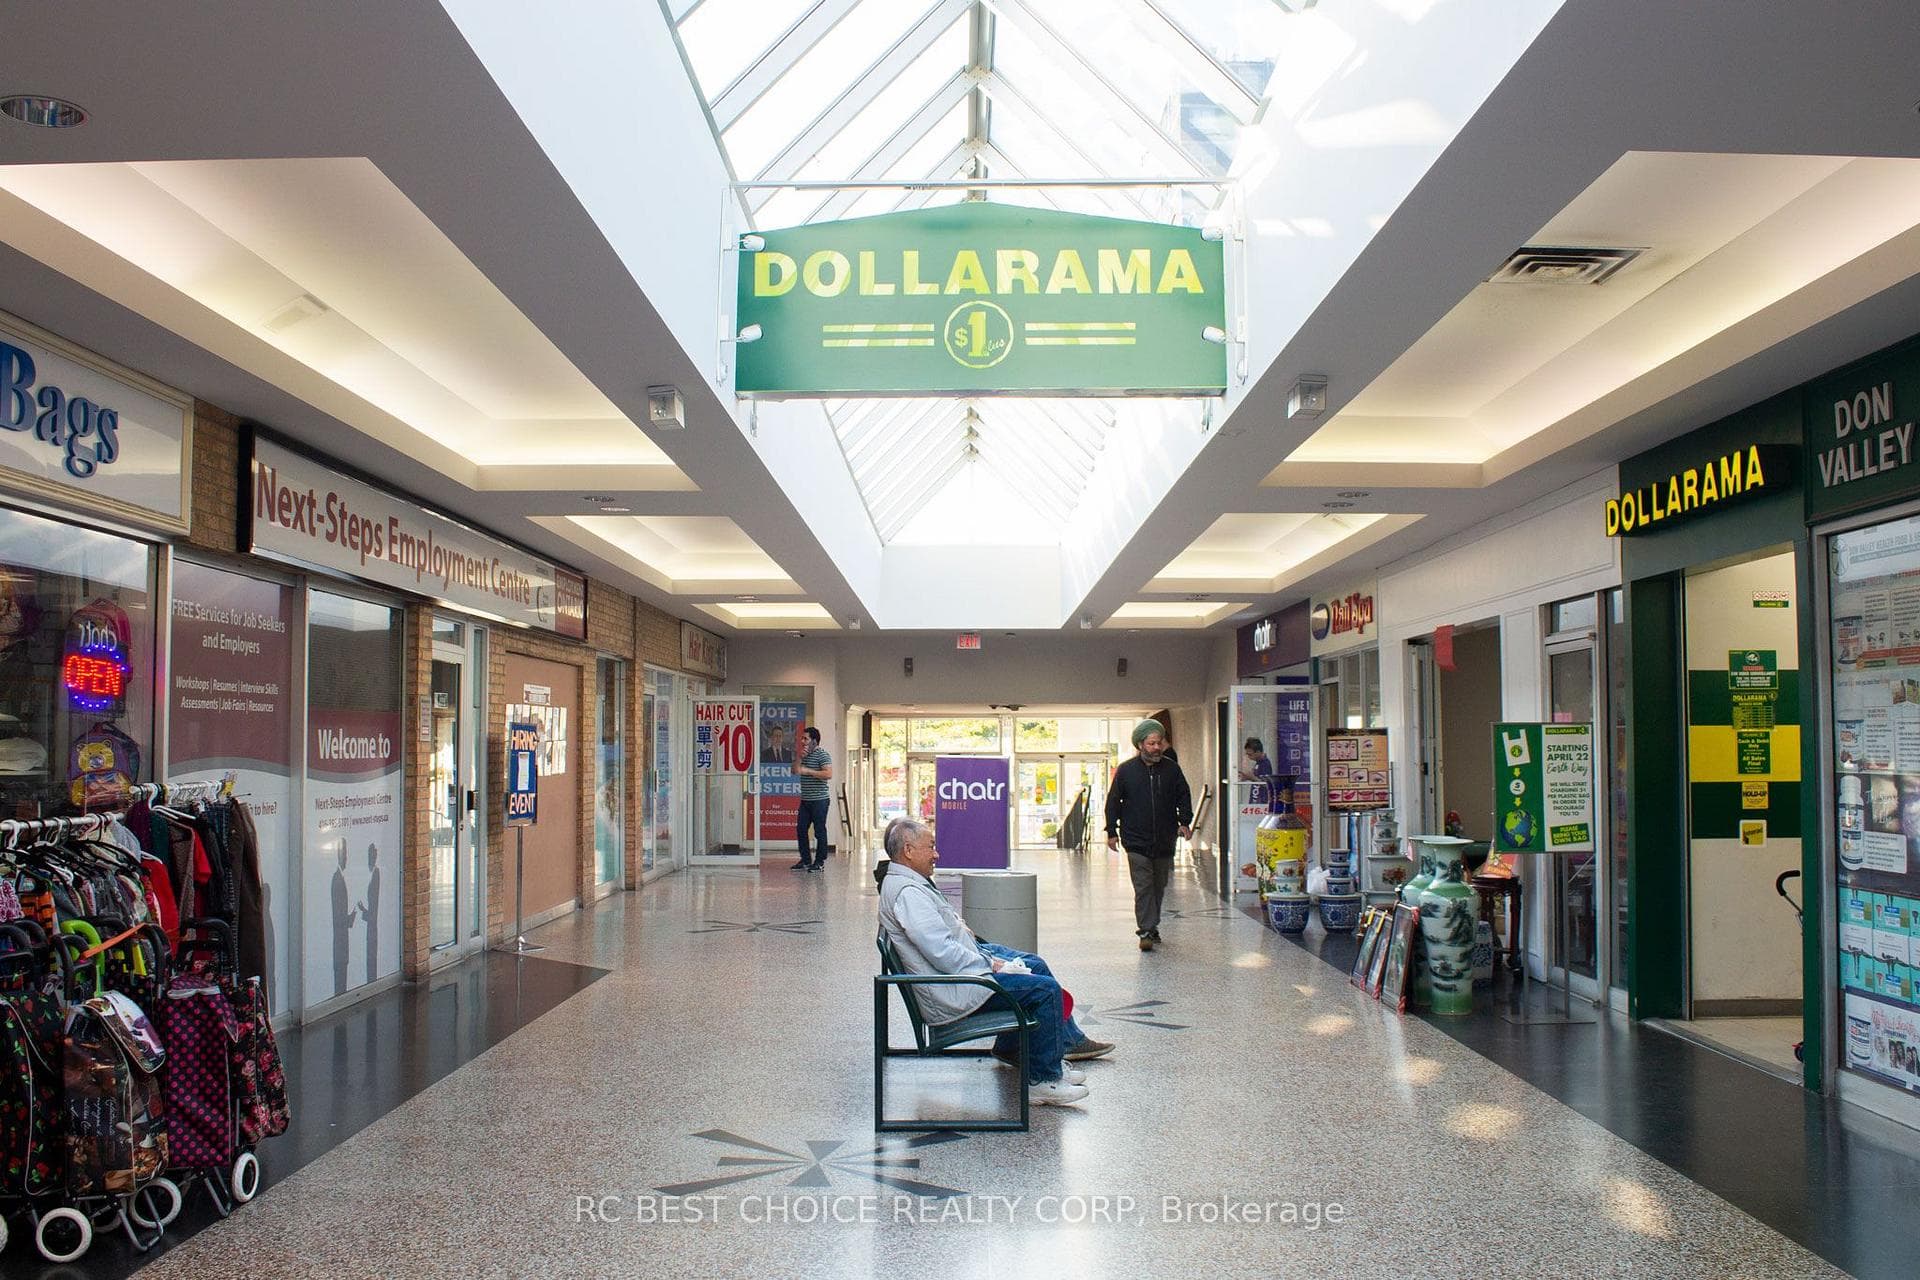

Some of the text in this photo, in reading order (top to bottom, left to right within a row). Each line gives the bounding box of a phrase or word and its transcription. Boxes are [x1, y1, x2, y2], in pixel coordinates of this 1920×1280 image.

[754, 249, 1205, 297] DOLLARAMA
[0, 341, 119, 478] Bags
[1834, 381, 1893, 439] DON
[1818, 421, 1914, 489] VALLEY
[1605, 444, 1765, 537] DOLLARAMA
[257, 462, 530, 605] Next-Steps Employment Centre
[172, 599, 285, 633] FREE Services for Job Seekers
[202, 632, 260, 656] and Employers
[959, 635, 977, 648] EXIT
[66, 655, 121, 695] OPEN
[176, 675, 279, 695] Workshops Resumes Interview Skills
[180, 696, 219, 710] Assessments
[248, 701, 274, 712] Resources
[696, 704, 724, 720] HAIR
[729, 704, 752, 720] CUT
[1289, 700, 1304, 710] LIFE
[318, 728, 391, 759] Welcome to
[1546, 744, 1589, 752] STARTING
[1547, 752, 1589, 761] APRIL 22
[760, 766, 791, 778] KEN
[1546, 762, 1588, 776] Earth Day
[938, 777, 1006, 801] chatr
[315, 796, 344, 810] Next-Steps
[345, 795, 376, 809] Employment
[509, 792, 536, 815] EVENT
[941, 801, 968, 811] MOBILE
